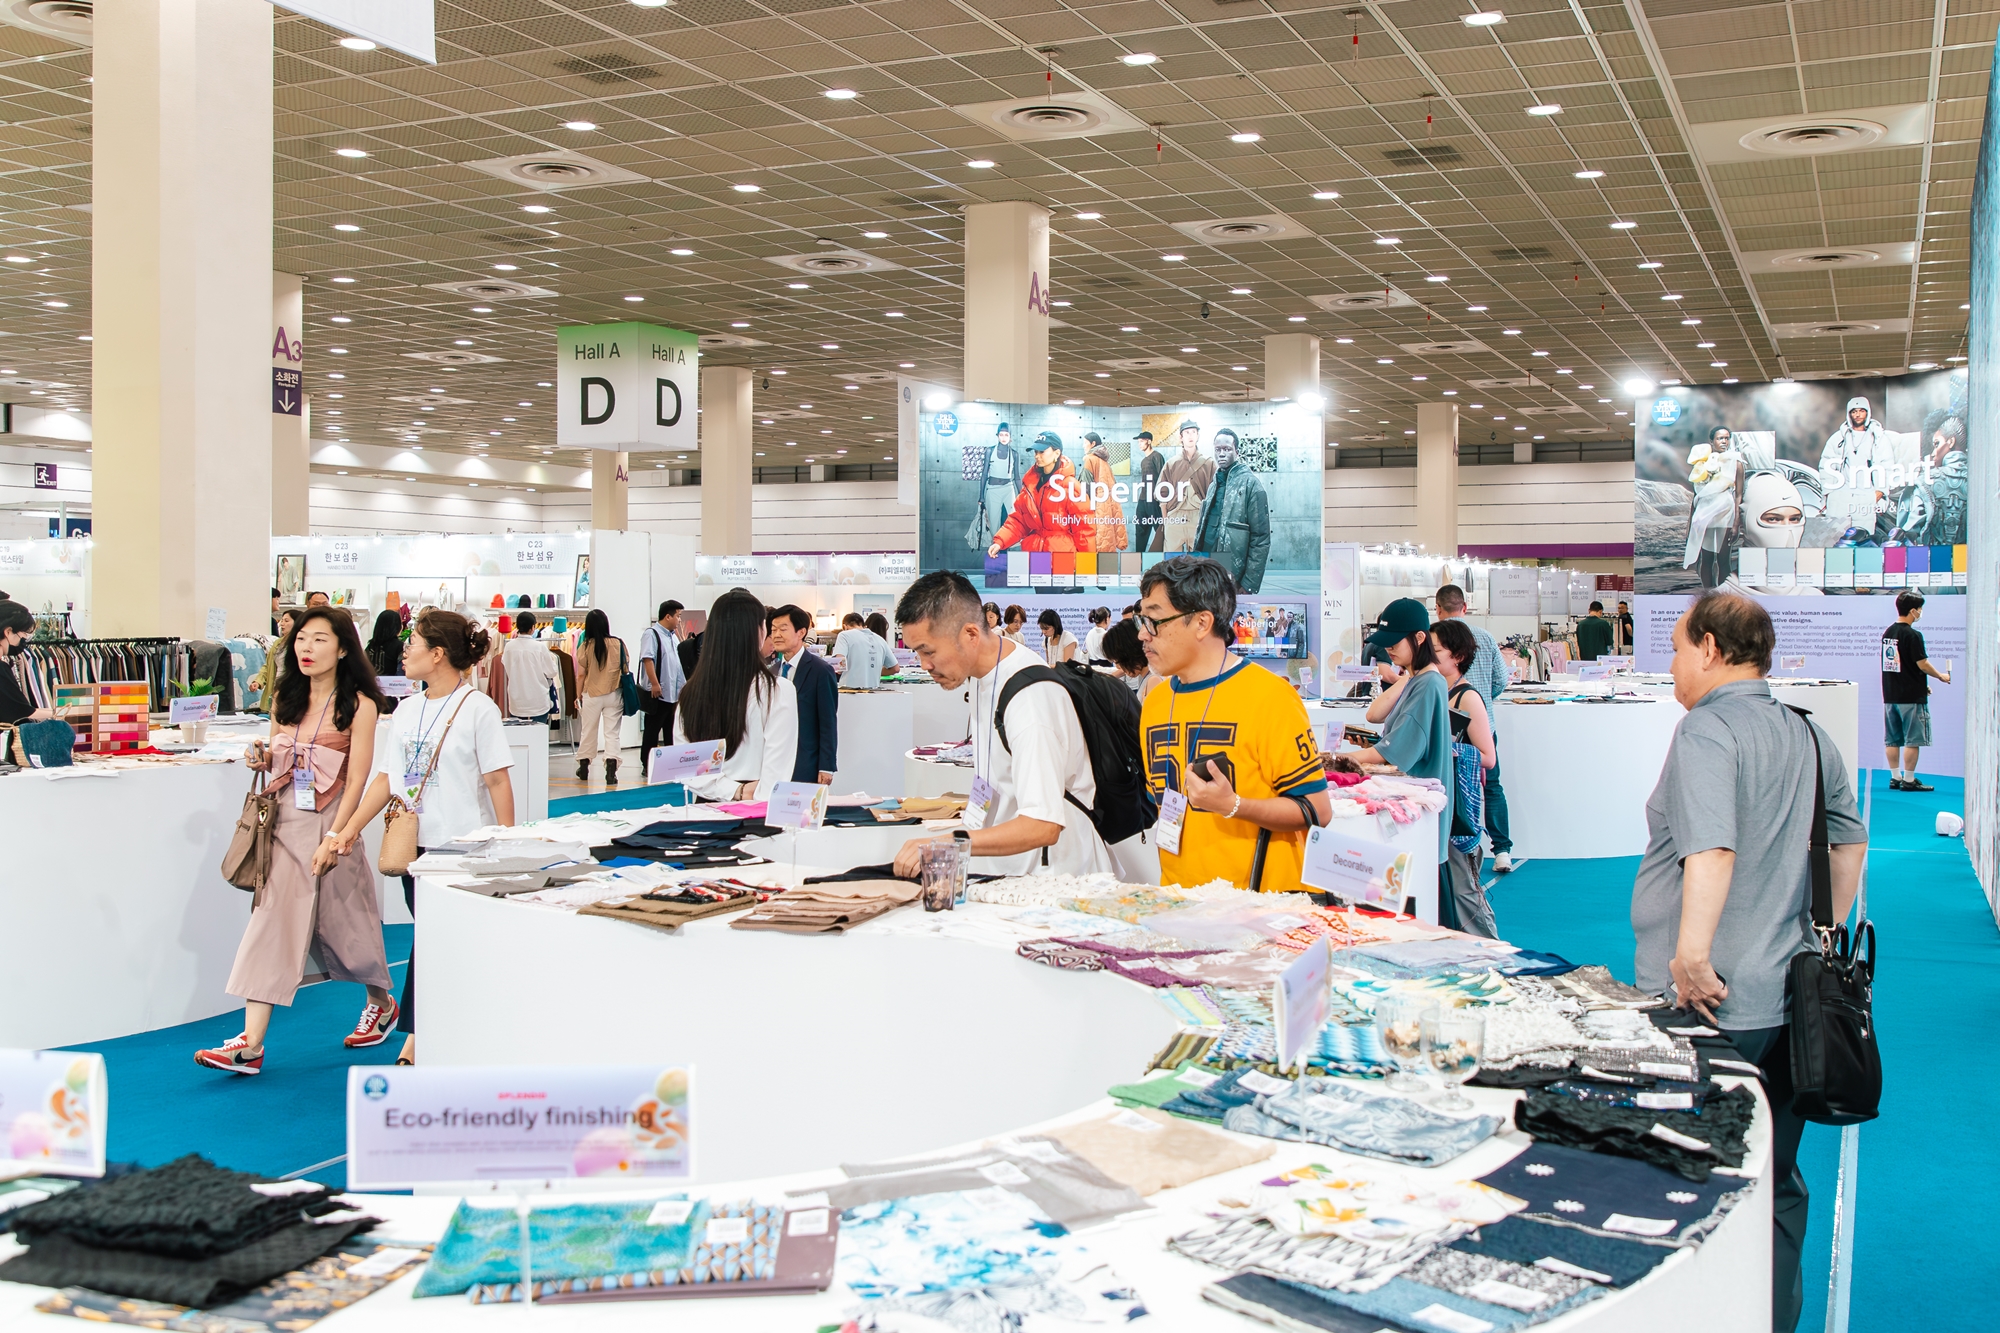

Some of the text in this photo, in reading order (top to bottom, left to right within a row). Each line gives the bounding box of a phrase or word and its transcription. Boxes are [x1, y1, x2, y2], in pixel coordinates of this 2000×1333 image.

[1028, 271, 1048, 315] A3
[272, 326, 302, 362] A3
[575, 342, 620, 360] Hall A
[652, 344, 686, 366] Hall A
[275, 372, 298, 384] 소화전
[580, 376, 616, 426] D
[656, 378, 682, 427] D
[616, 464, 628, 482] A4
[1822, 454, 1936, 490] Smart
[1048, 474, 1190, 510] Superior
[1052, 514, 1187, 526] Highly functional & advanced
[1848, 502, 1886, 516] Digital
[1889, 503, 1897, 515] &
[1239, 619, 1278, 630] Superior
[1294, 728, 1319, 761] 55
[679, 755, 699, 763] Classic
[787, 798, 801, 808] Luxury
[1333, 853, 1374, 875] Decorative
[384, 1106, 654, 1130] Eco-friendly finishing
